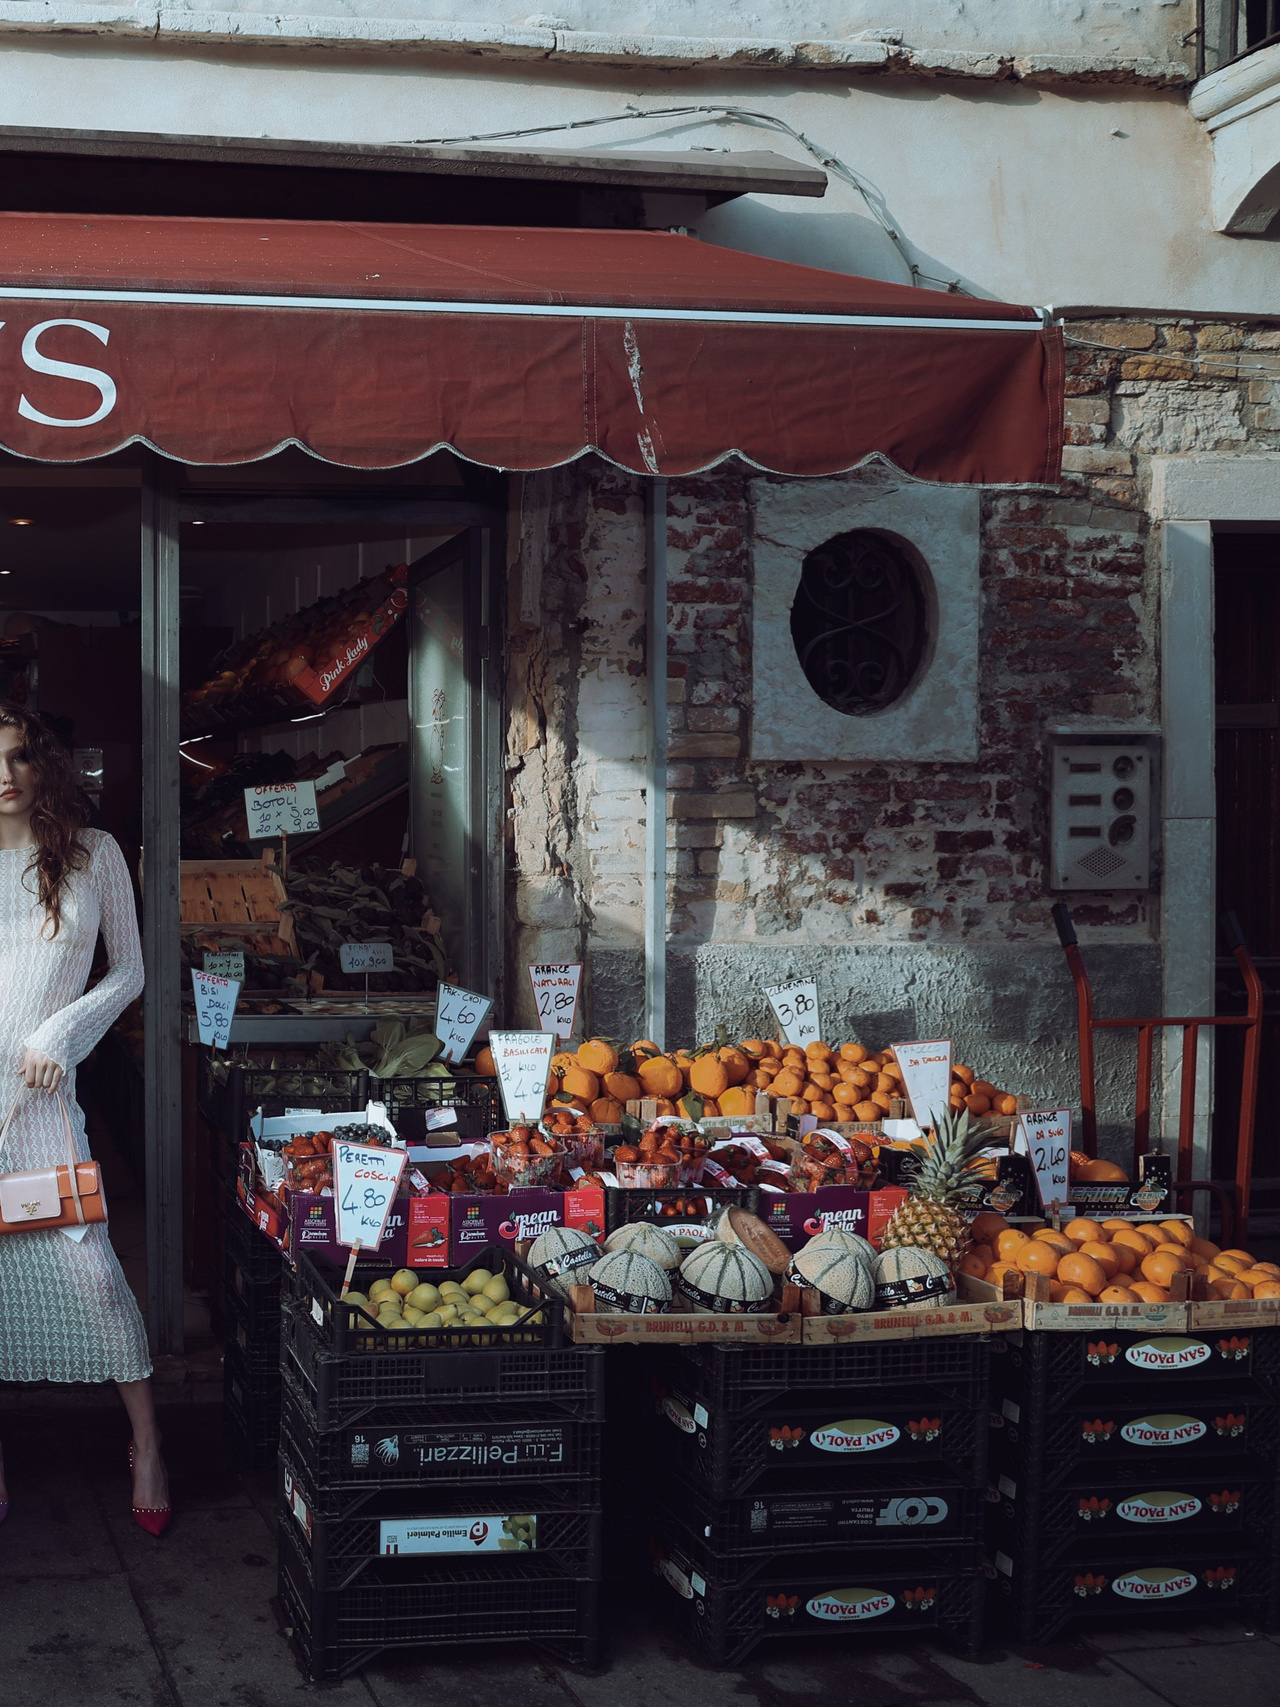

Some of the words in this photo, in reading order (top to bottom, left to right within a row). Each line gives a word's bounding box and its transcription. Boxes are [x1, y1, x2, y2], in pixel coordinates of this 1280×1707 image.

[320, 658, 345, 691] Pink
[344, 636, 368, 666] Lady
[255, 784, 297, 795] OFFERTA
[251, 796, 297, 811] BOTOLI
[535, 965, 570, 975] ARANCE
[195, 972, 228, 987] OFFERTA
[533, 978, 575, 988] NATURALI
[769, 976, 816, 998] CLEMENTINE
[201, 984, 218, 995] BISI
[540, 991, 574, 1017] 2.80
[439, 1002, 476, 1024] 4.60
[557, 1015, 571, 1024] KILO
[498, 1034, 542, 1045] FRAGOLE
[502, 1046, 548, 1057] BASILICATA
[1026, 1112, 1058, 1125] ARANCE
[1036, 1131, 1045, 1139] DA
[1048, 1129, 1065, 1138] SUGO
[1034, 1147, 1065, 1172] 2.40
[1052, 1174, 1066, 1185] KILO
[341, 1184, 386, 1215] 4.80
[516, 1209, 561, 1224] mean
[821, 1208, 865, 1224] mean
[516, 1222, 551, 1241] frutta
[563, 1250, 592, 1268] Castello
[592, 1282, 617, 1302] Castello
[678, 1279, 701, 1301] Castello
[645, 1320, 693, 1333] BRUNELLI
[874, 1315, 920, 1330] BRUNELLI
[1179, 1345, 1206, 1363] SAN
[866, 1428, 895, 1446] SAN
[1174, 1423, 1201, 1440] SAN
[355, 1435, 365, 1444] 16
[754, 1501, 765, 1509] 16
[1169, 1500, 1196, 1517] SAN
[407, 1530, 440, 1540] Palmieri
[442, 1529, 468, 1538] Emilio
[1164, 1576, 1192, 1593] SAN
[862, 1597, 890, 1615] SAN
